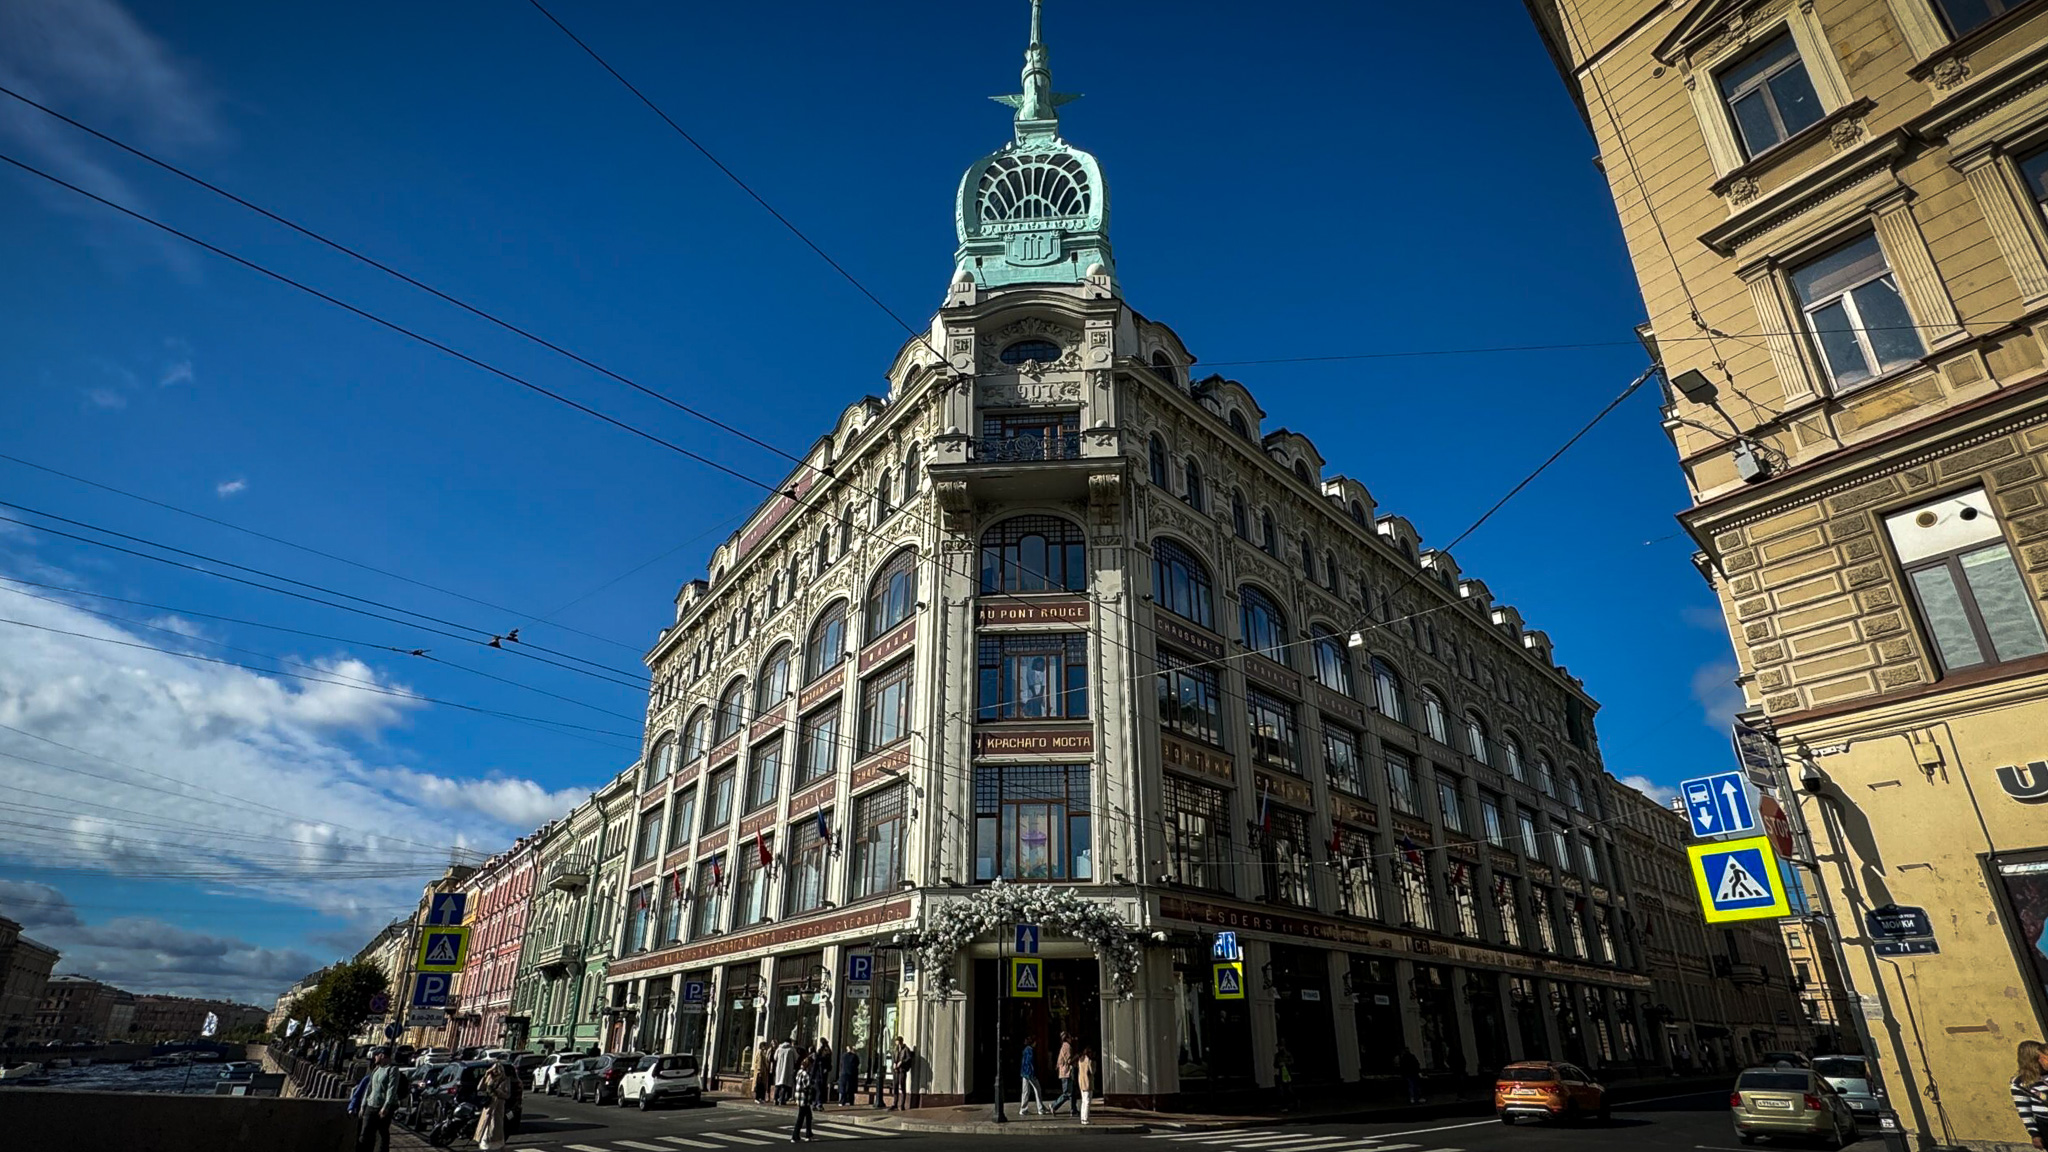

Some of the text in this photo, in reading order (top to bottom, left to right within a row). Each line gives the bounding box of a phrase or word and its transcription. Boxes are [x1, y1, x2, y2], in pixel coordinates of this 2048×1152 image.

[1008, 384, 1054, 401] 1907
[979, 607, 1085, 619] AU PONT ROUGE
[1157, 619, 1220, 656] CHAUSSURES
[975, 736, 1091, 749] У КРАСНАГО МОСТА
[1164, 744, 1231, 775] ЗОНТИКИ
[1763, 815, 1789, 838] STOP
[1206, 908, 1272, 931] ESDERS
[747, 931, 776, 948] МОСТА
[1897, 942, 1911, 952] 71
[856, 958, 868, 978] P
[422, 977, 444, 1003] P
